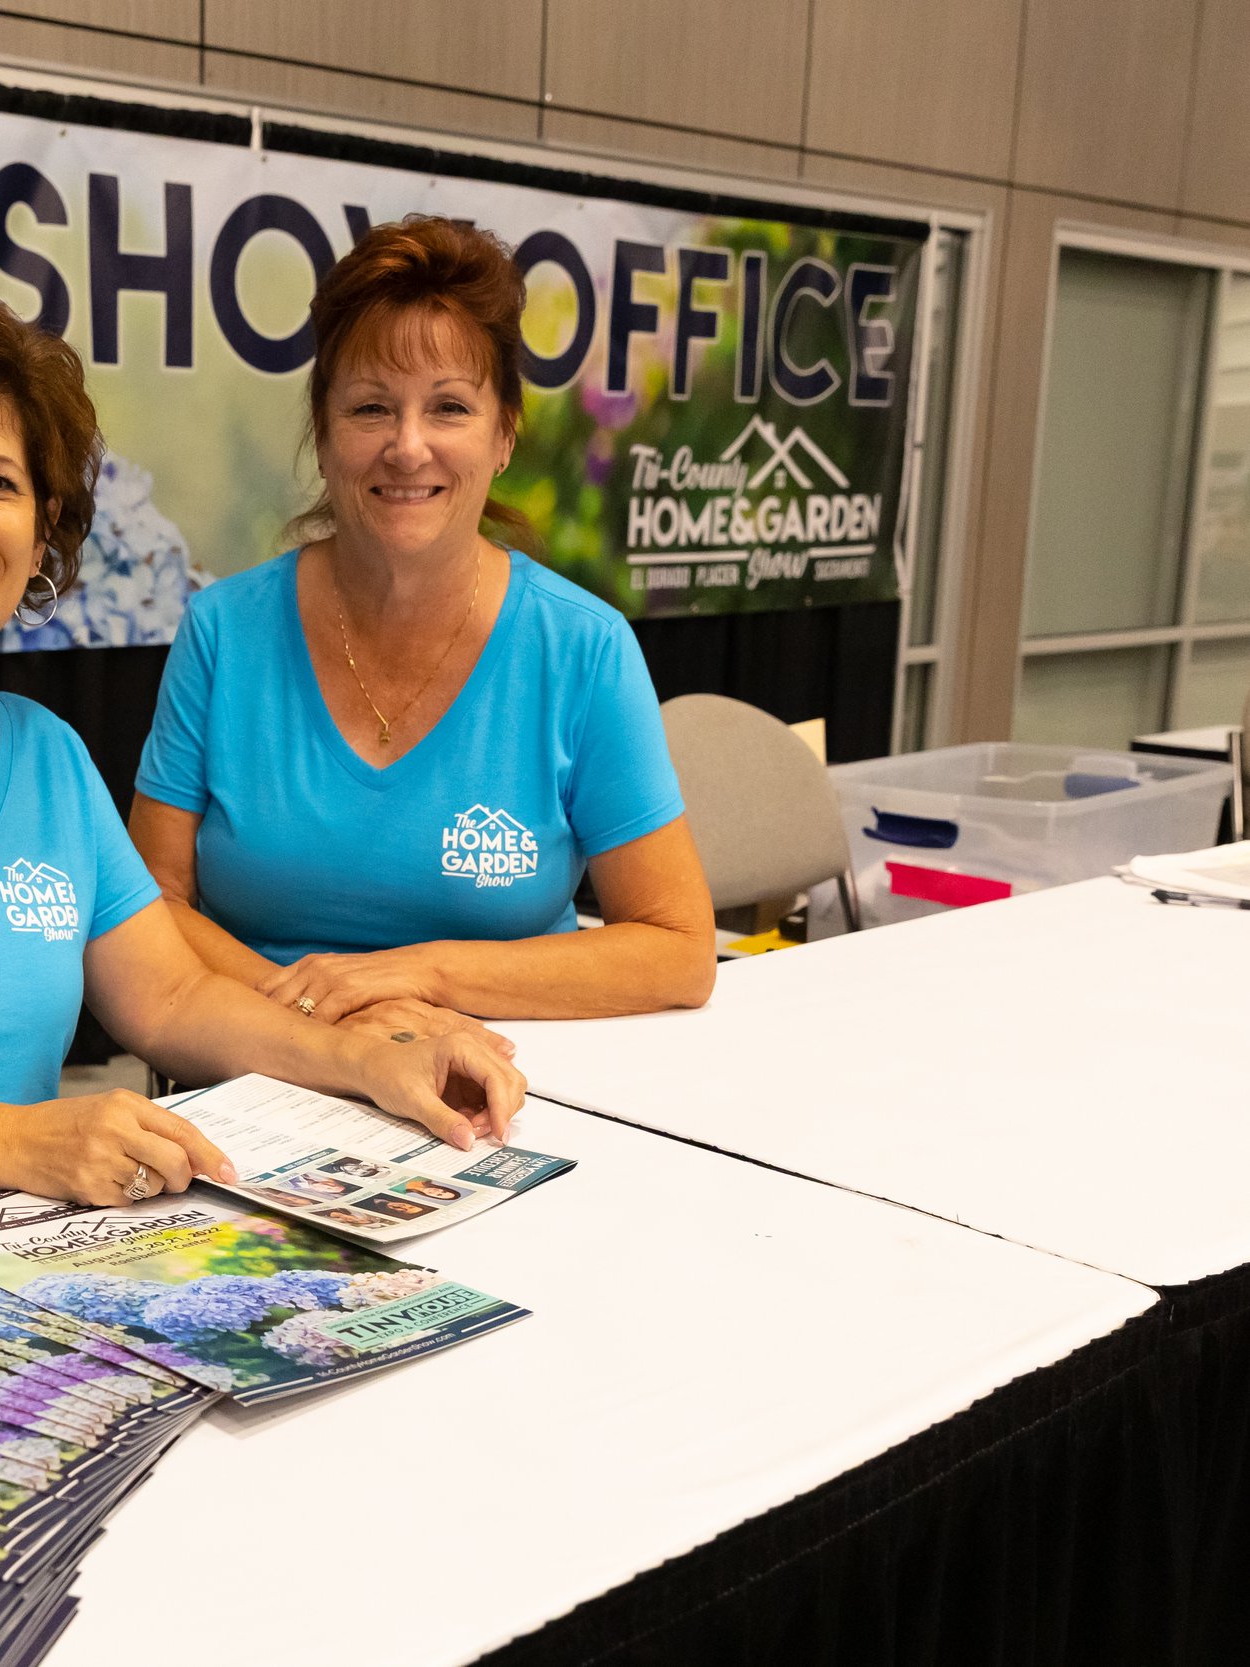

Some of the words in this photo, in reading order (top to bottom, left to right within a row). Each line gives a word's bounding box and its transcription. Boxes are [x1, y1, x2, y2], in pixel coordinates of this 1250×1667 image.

[513, 229, 899, 408] OFFICE
[745, 547, 811, 591] Show
[454, 813, 478, 829] The
[441, 850, 538, 874] GARDEN
[3, 866, 25, 882] The
[475, 873, 514, 889] Show
[43, 927, 73, 942] Show
[120, 1230, 164, 1246] Show
[173, 1237, 214, 1251] Center
[72, 1250, 127, 1268] August
[414, 1302, 473, 1328] CONFERENCE
